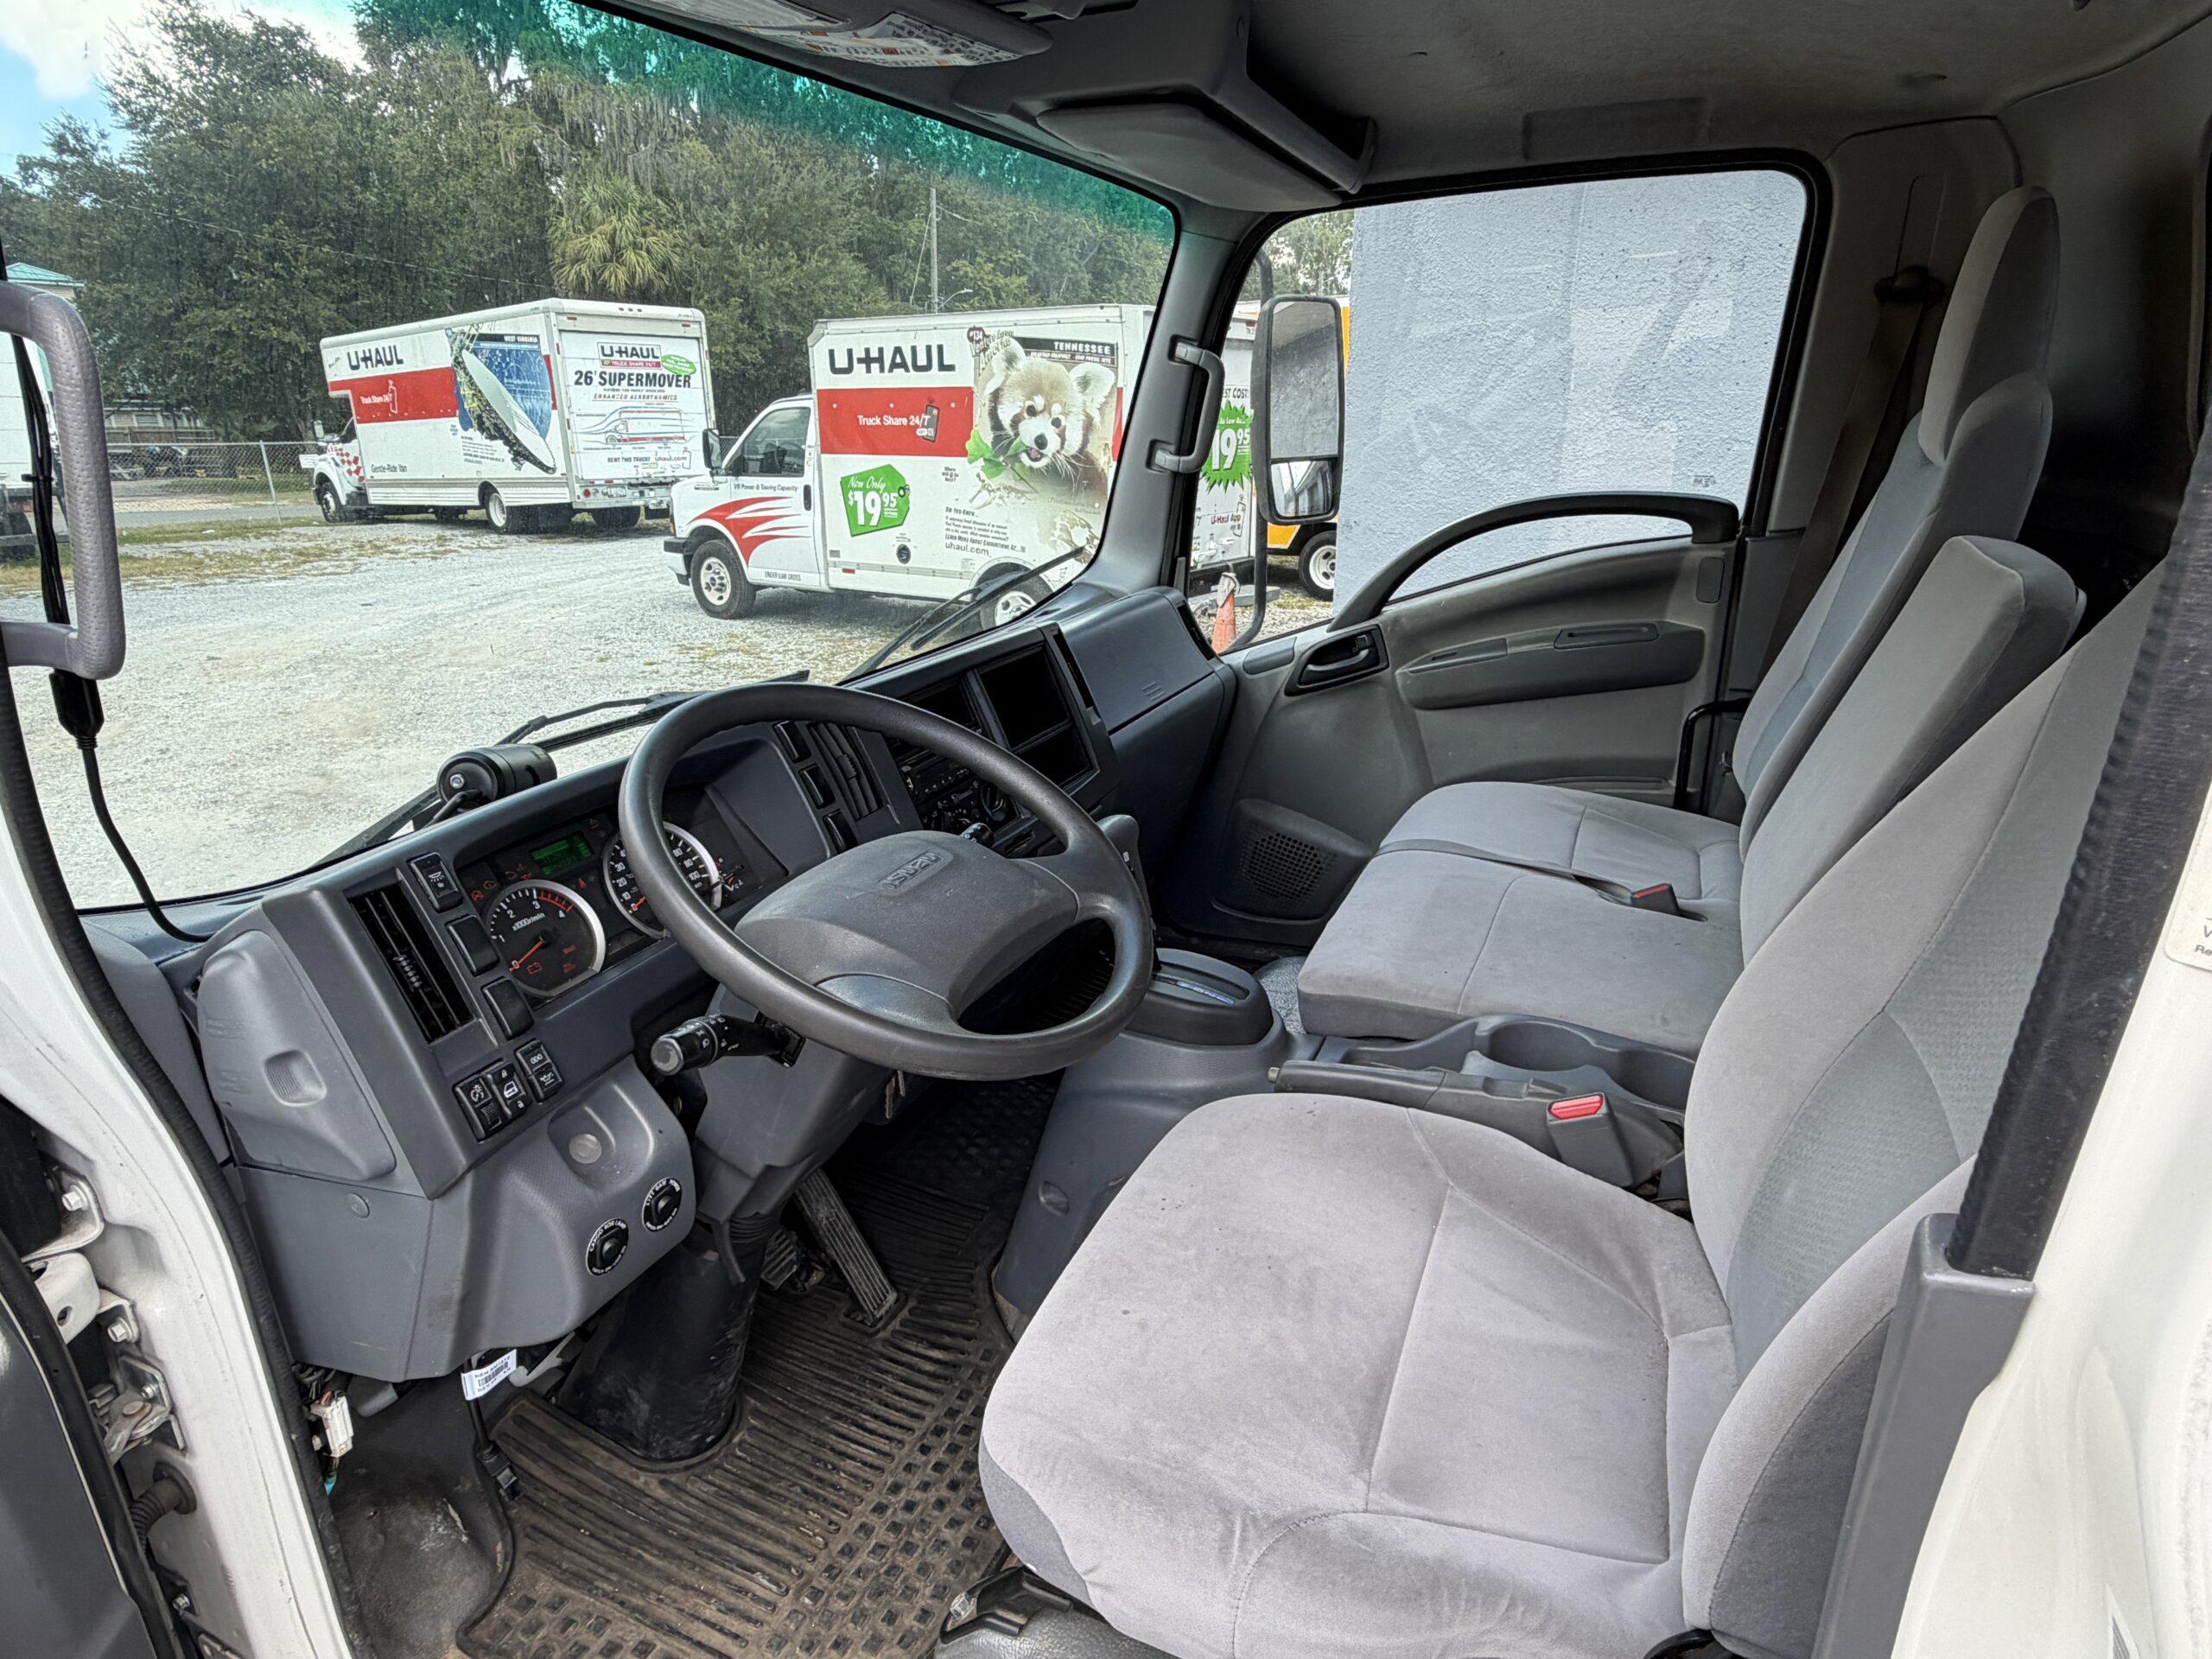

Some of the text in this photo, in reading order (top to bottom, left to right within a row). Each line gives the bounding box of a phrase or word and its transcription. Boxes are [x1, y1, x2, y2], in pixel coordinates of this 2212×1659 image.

[601, 345, 659, 359] U-HAUL
[1054, 341, 1111, 355] TENNESSEE
[347, 345, 404, 371] U-HAUL
[828, 344, 956, 375] U-HAUL
[598, 371, 691, 389] SUPERMOVER
[857, 415, 880, 426] Truck
[883, 415, 907, 426] Share
[866, 475, 886, 494] Only
[614, 861, 626, 873] 30
[616, 878, 627, 887] 20
[532, 899, 540, 909] 3
[507, 910, 516, 919] 2
